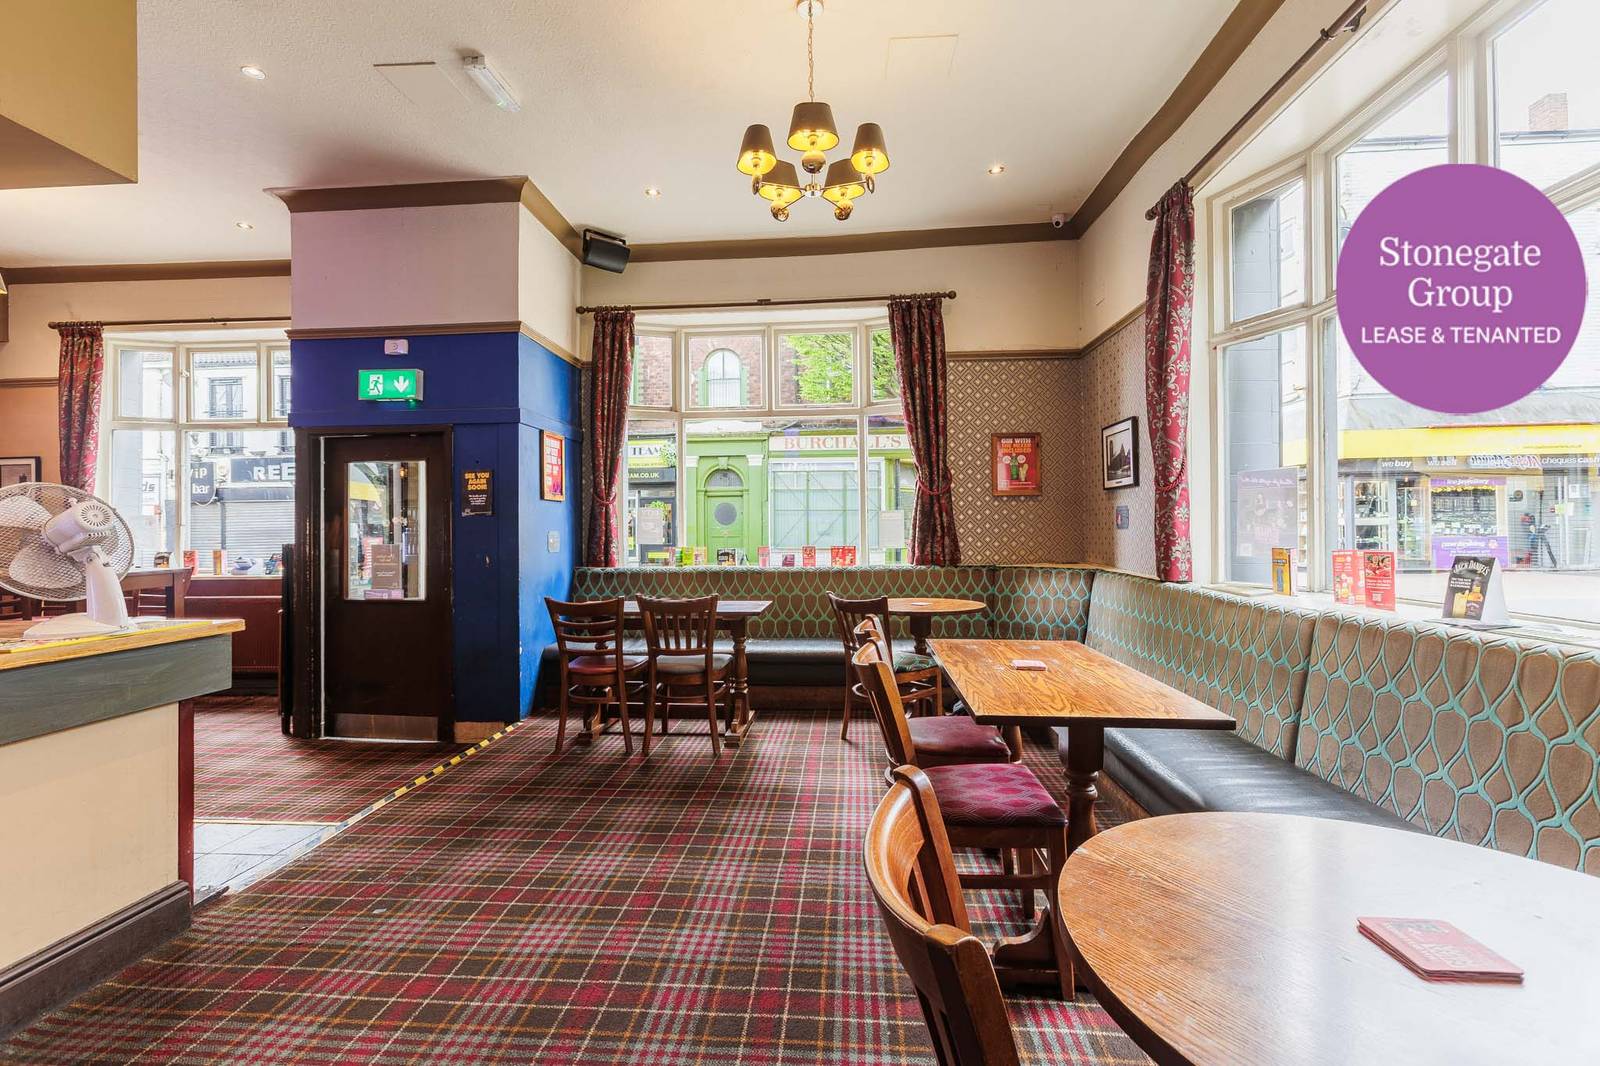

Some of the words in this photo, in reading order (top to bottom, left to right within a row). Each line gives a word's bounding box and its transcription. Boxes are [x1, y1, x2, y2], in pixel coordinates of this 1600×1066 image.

[1394, 458, 1412, 468] buy
[1541, 457, 1577, 465] cheques
[192, 484, 209, 494] bar
